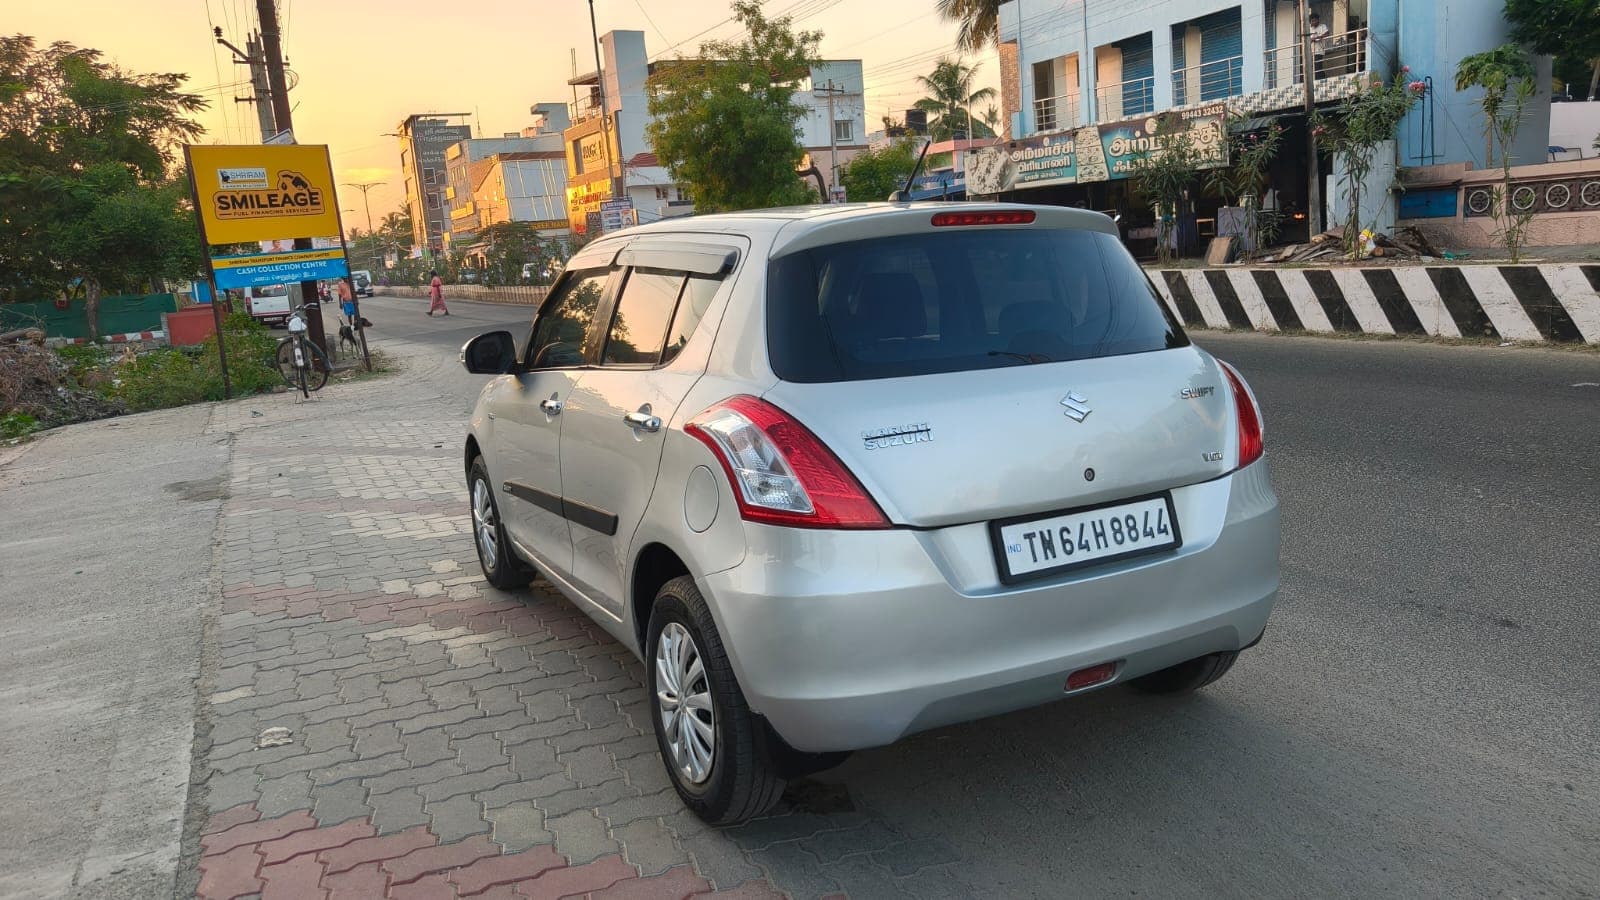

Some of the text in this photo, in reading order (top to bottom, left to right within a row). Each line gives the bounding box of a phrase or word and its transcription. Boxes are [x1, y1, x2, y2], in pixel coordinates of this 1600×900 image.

[1181, 110, 1202, 120] 99443
[1018, 155, 1071, 173] பிரியாணி
[230, 171, 266, 179] SHRIRAM
[217, 192, 321, 210] SMILEAGE
[236, 260, 327, 275] CASH COLLECTION CENTRE
[1181, 386, 1214, 400] SWIFT
[863, 430, 935, 451] SUZUKI
[1007, 508, 1169, 563] IND TN64H8844
